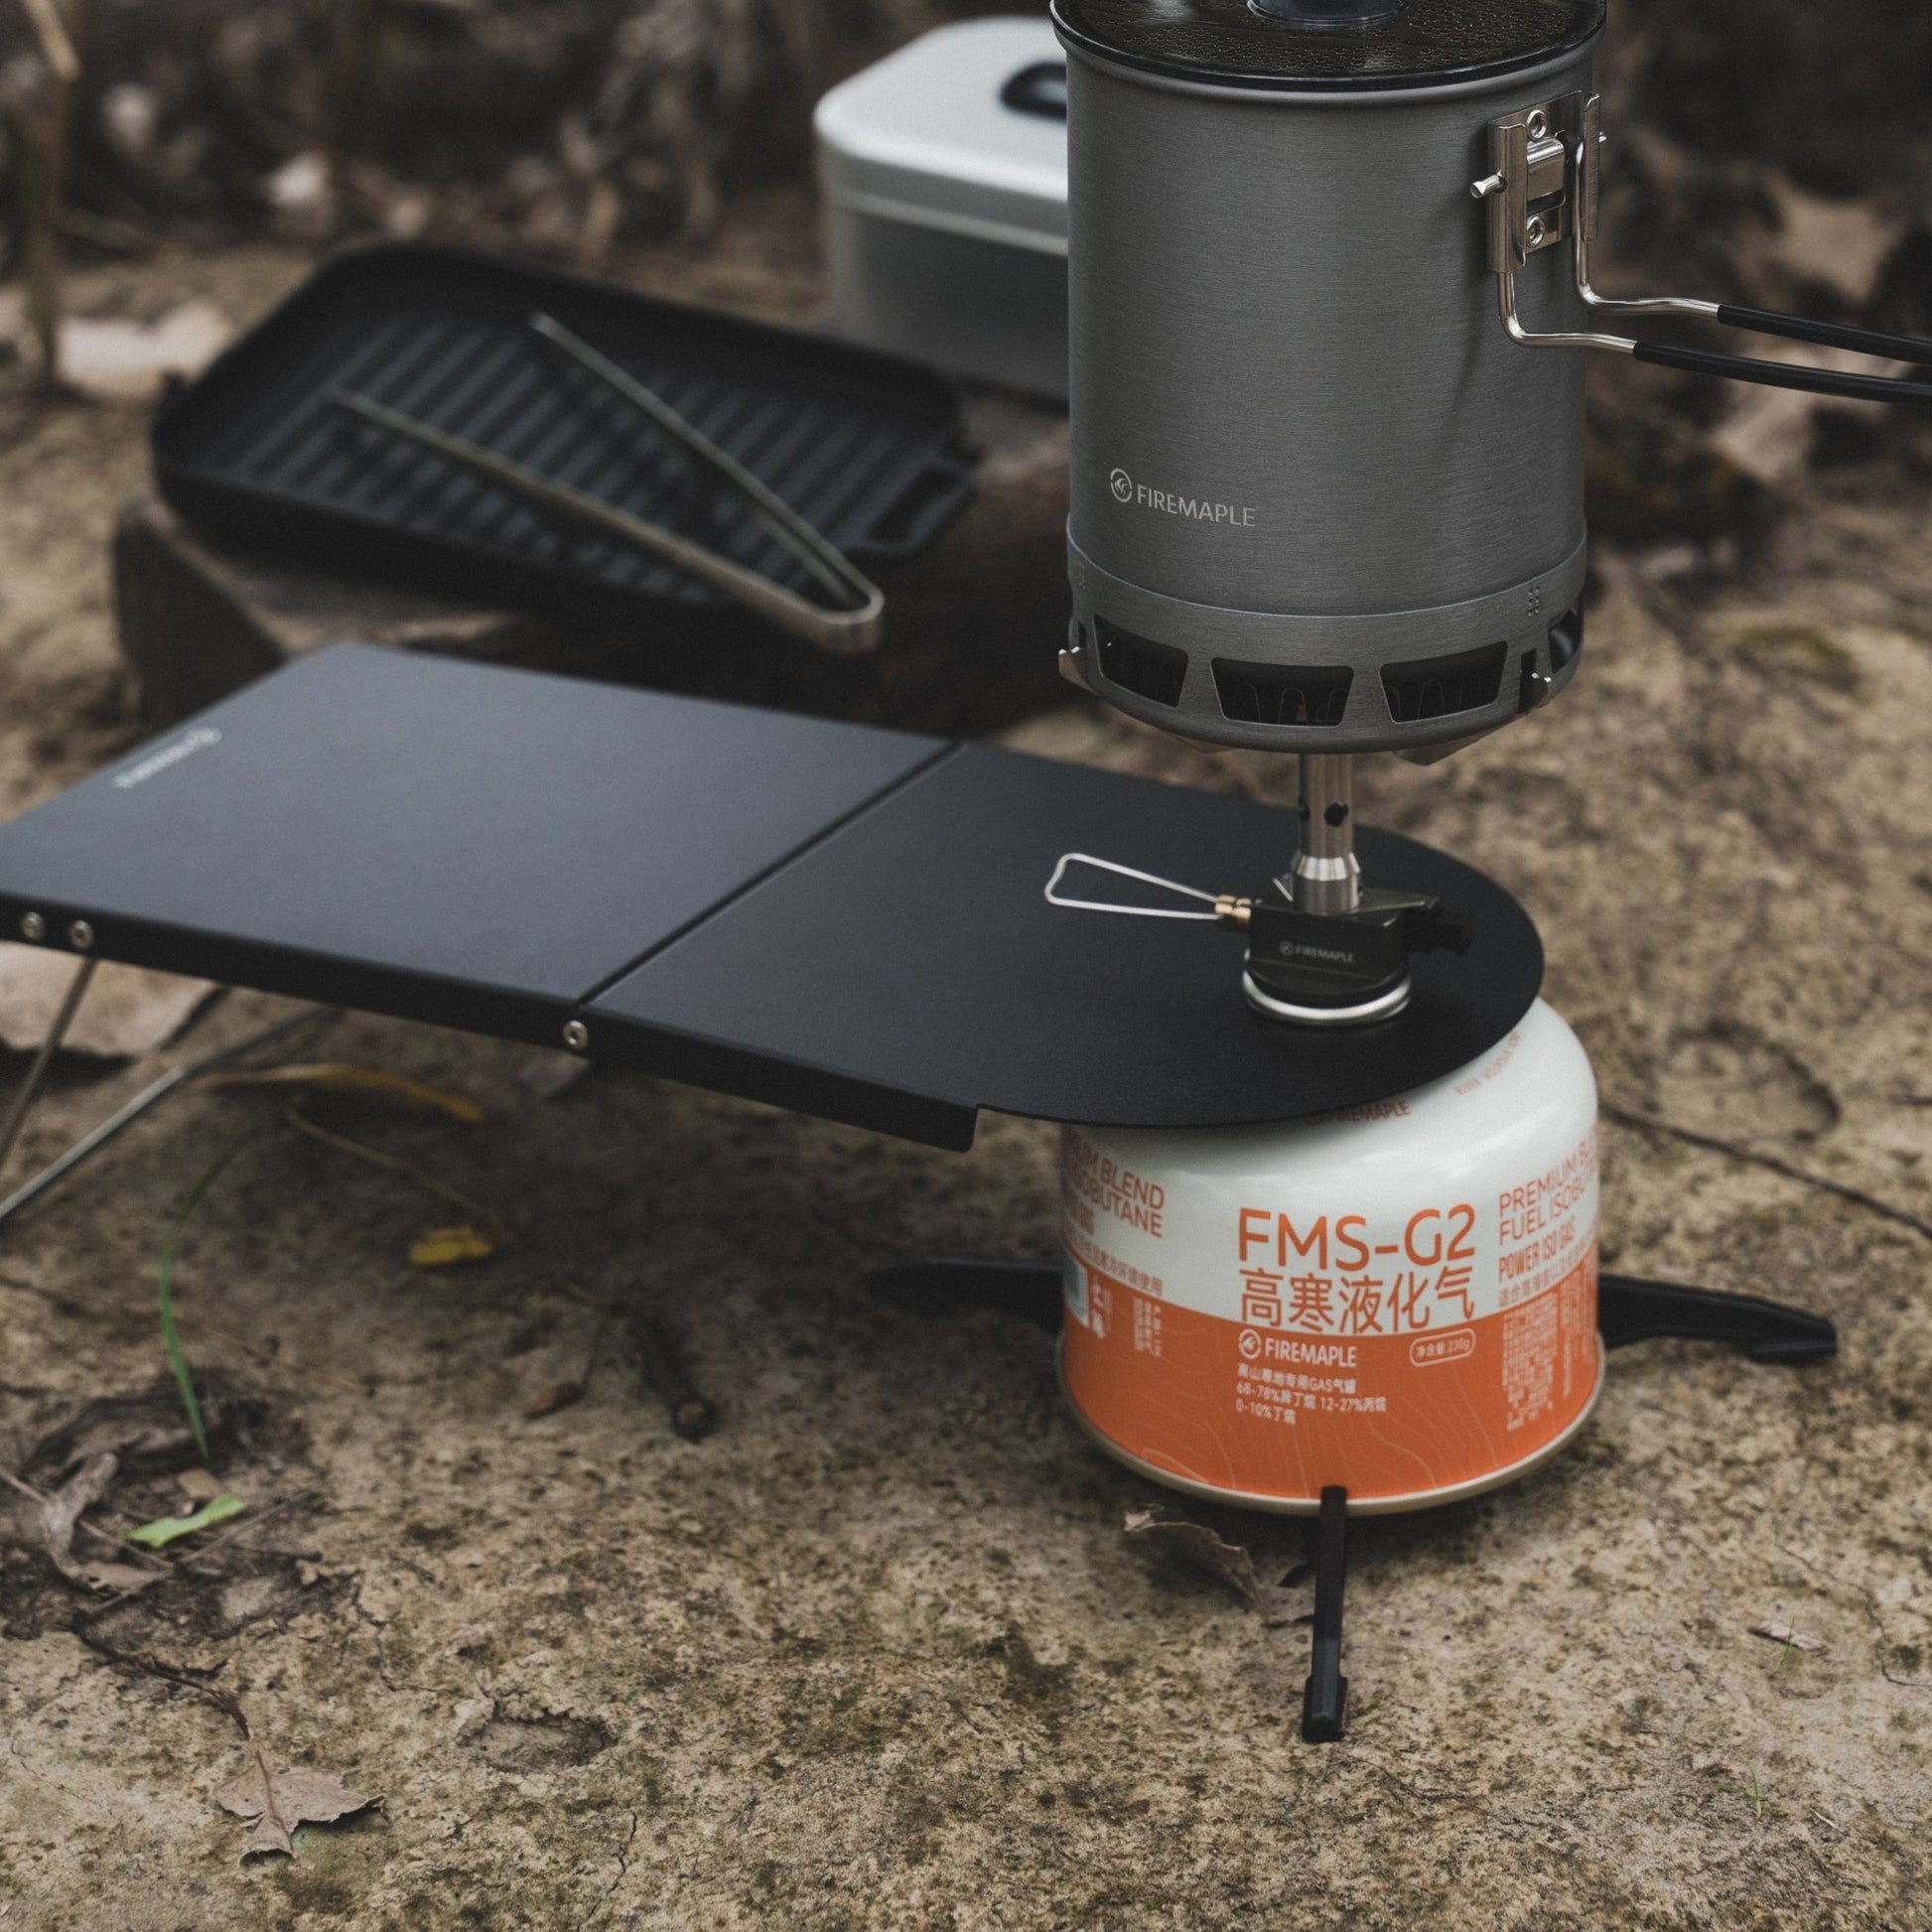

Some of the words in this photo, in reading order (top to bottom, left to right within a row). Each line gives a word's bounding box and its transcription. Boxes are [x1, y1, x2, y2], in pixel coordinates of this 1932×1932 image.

[1137, 484, 1256, 527] FIREMAPLE
[1294, 944, 1354, 964] FIREMAPLE
[1100, 1158, 1165, 1210] BLEND
[1499, 1150, 1577, 1217] PREMIUM
[1238, 1203, 1475, 1272] FMS-G2
[1499, 1207, 1546, 1246] FUEL
[1498, 1241, 1539, 1284] POWER
[1239, 1266, 1474, 1334] 高寒液化气
[1265, 1337, 1357, 1367] FIREMAPLE
